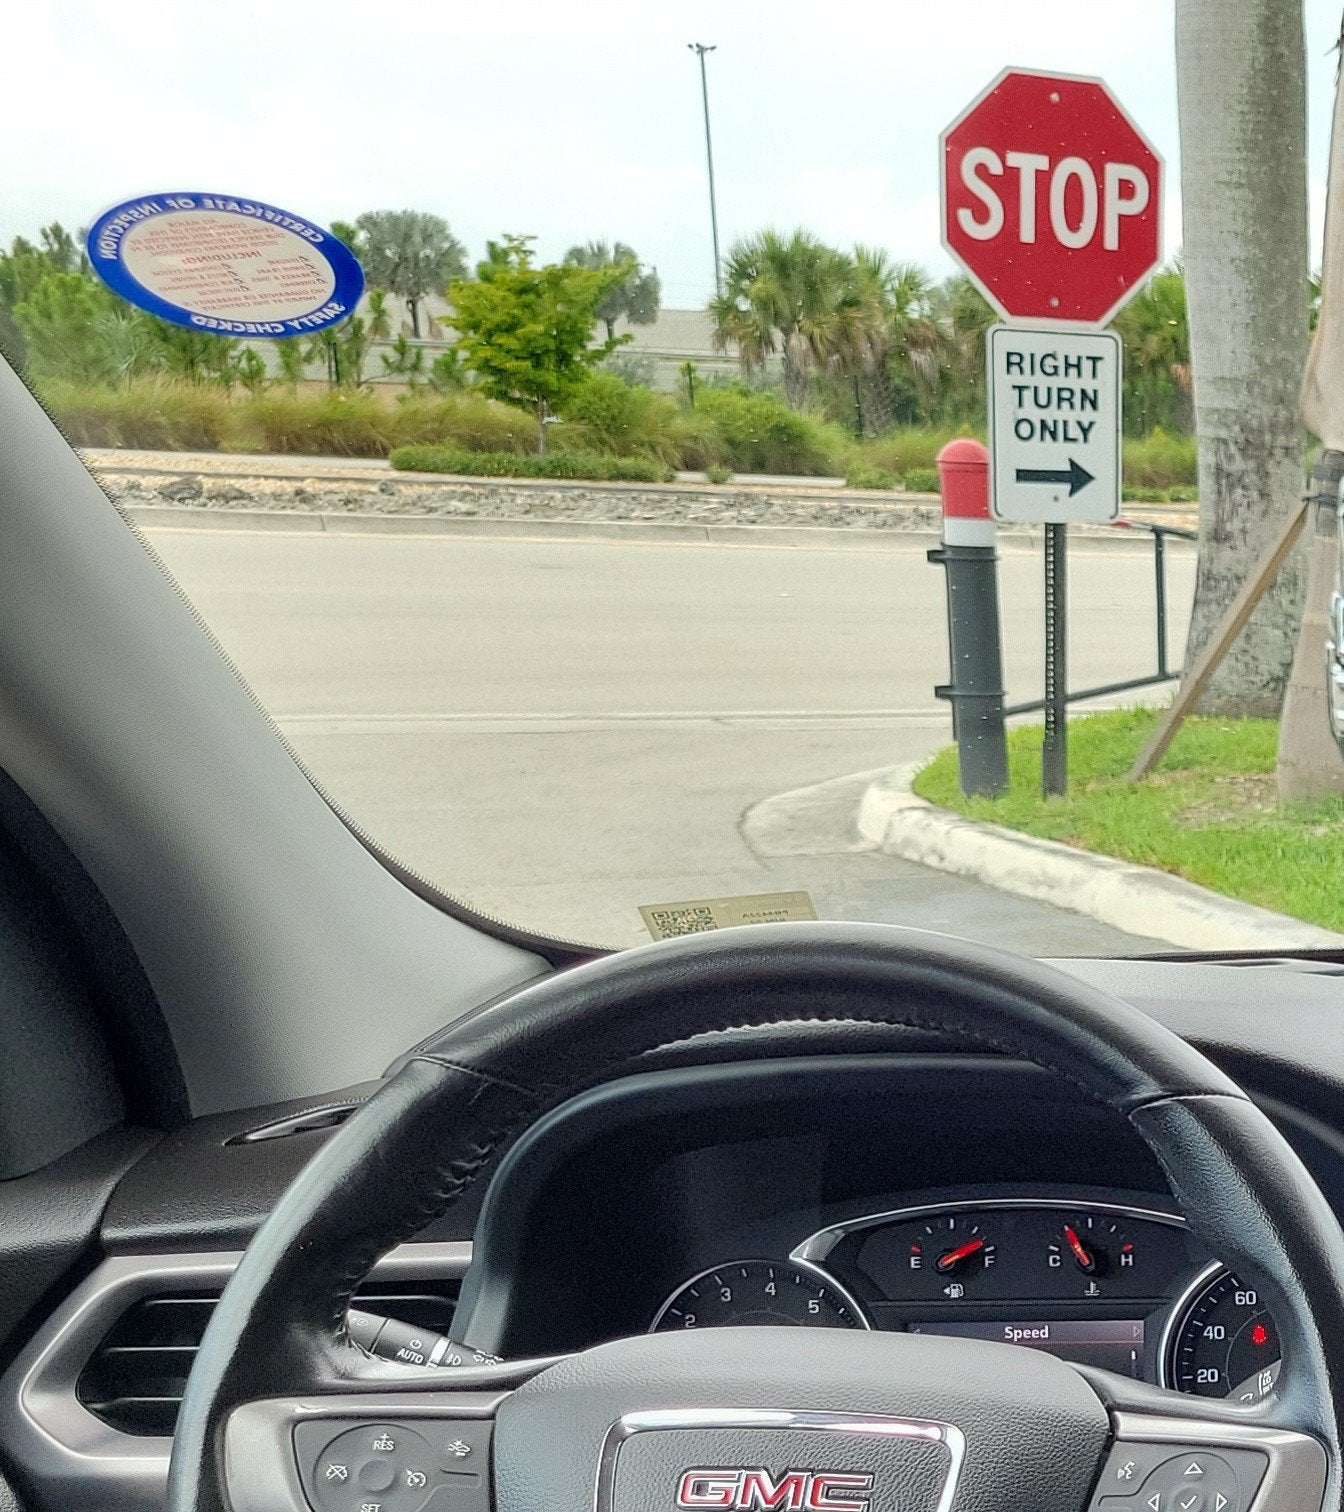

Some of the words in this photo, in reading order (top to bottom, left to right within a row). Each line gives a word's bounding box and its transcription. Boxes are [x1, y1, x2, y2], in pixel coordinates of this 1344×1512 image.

[956, 146, 1150, 251] STOP
[1006, 350, 1104, 379] RIGHT
[1012, 385, 1099, 412] TURN
[1014, 417, 1097, 444] ONLY
[911, 1257, 921, 1268] E
[984, 1256, 995, 1267] F
[1049, 1256, 1061, 1267] C
[1121, 1255, 1133, 1266] H
[720, 1288, 732, 1301] 3
[764, 1283, 776, 1296] 4
[1235, 1291, 1257, 1305] 60
[808, 1300, 820, 1313] 5
[684, 1315, 696, 1328] 2
[1004, 1326, 1049, 1342] Speed
[1203, 1326, 1225, 1340] 40
[396, 1347, 424, 1364] AUTO
[1197, 1369, 1219, 1383] 20
[373, 1440, 395, 1451] RES
